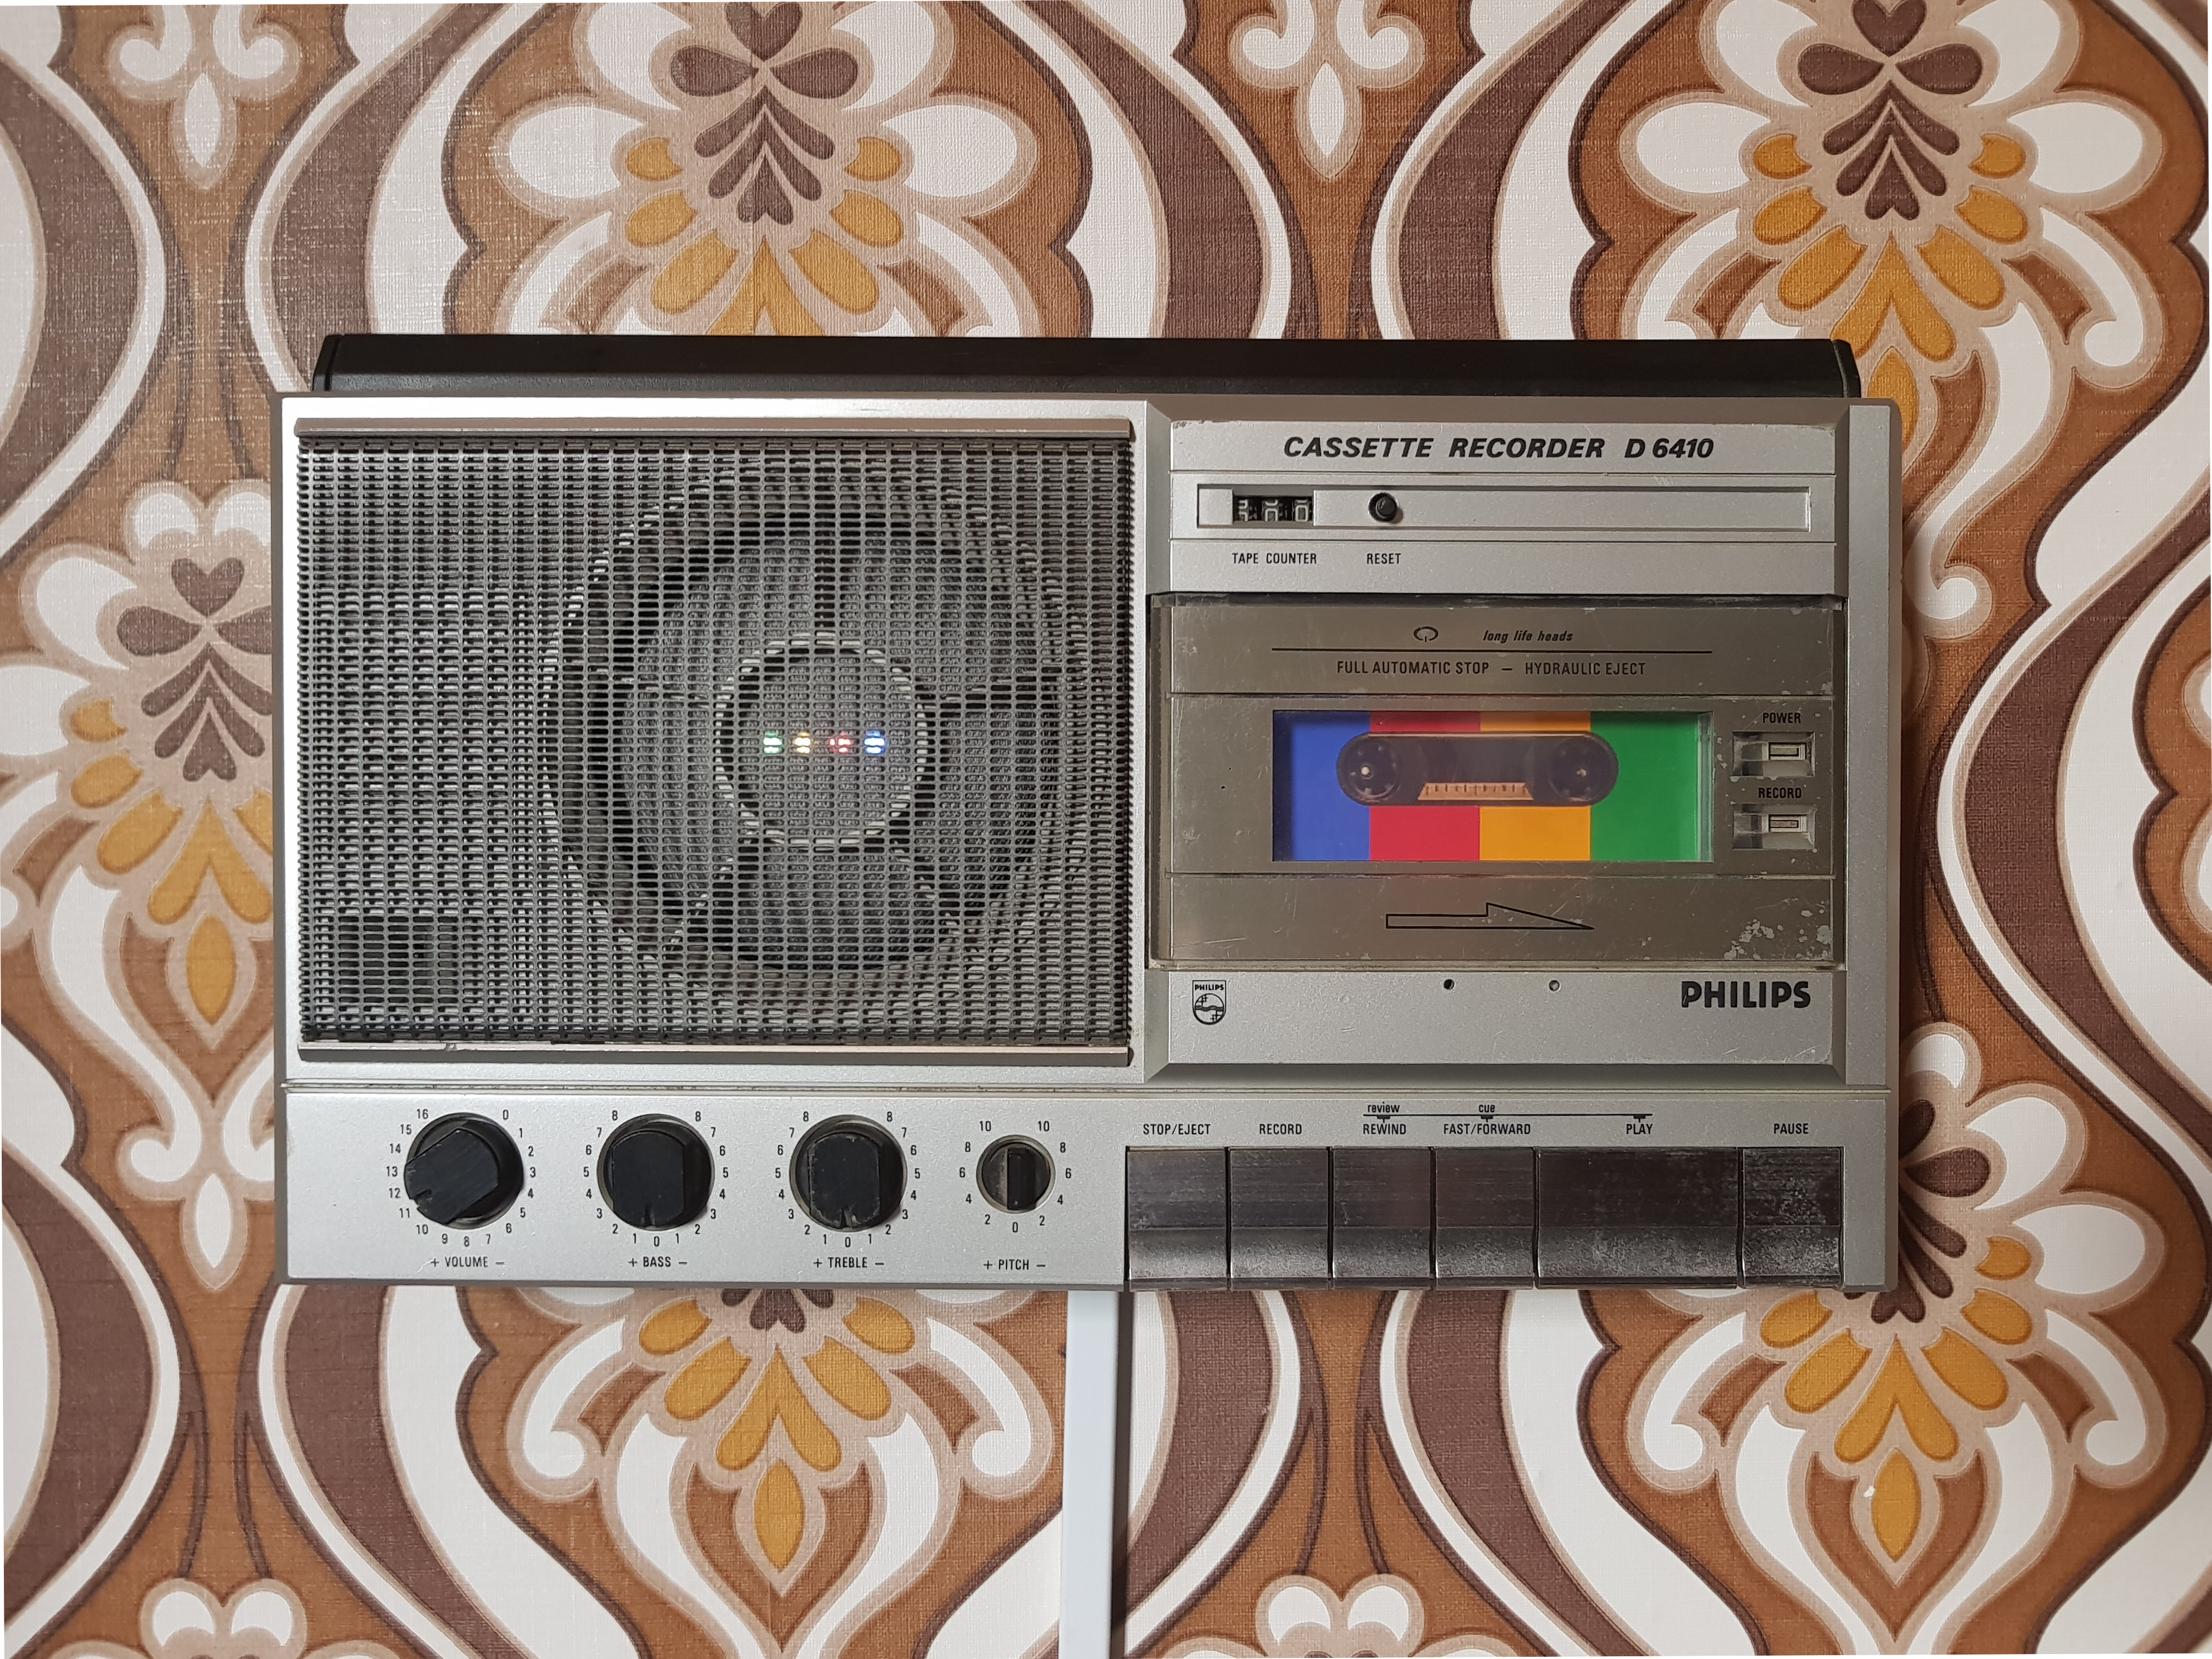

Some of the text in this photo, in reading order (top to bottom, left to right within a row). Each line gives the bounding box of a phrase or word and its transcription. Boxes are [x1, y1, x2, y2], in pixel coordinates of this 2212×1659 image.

[1284, 437, 1434, 458] CASSETTE
[1448, 437, 1605, 458] RECORDER
[1652, 438, 1714, 458] 6410
[1232, 552, 1317, 564] TAPE COUNTER
[1367, 553, 1401, 565] RESET
[1482, 630, 1573, 644] long life heads
[1338, 661, 1368, 674] FULL
[1372, 661, 1451, 675] AUTOMATIC
[1455, 661, 1489, 675] STOP
[1525, 662, 1600, 675] HYDRAULIC
[1606, 662, 1646, 675] EJECT
[1762, 712, 1801, 724] POWER
[1758, 787, 1802, 799] RECORD
[1681, 981, 1811, 1008] PHILIPS
[1368, 1101, 1400, 1113] review
[1479, 1104, 1496, 1113] cue
[416, 1108, 428, 1120] 16
[503, 1109, 509, 1120] 0
[612, 1110, 618, 1121] 8
[695, 1111, 701, 1122] 8
[803, 1111, 809, 1122] 8
[887, 1111, 893, 1122] 8
[400, 1124, 412, 1135] 15
[979, 1120, 991, 1132] 10
[1038, 1120, 1049, 1132] 10
[1143, 1124, 1211, 1135] STOP/EJECT
[1259, 1124, 1302, 1135] RECORD
[1363, 1123, 1407, 1135] REWIND
[1443, 1123, 1531, 1135] FAST/FORWARD
[1626, 1124, 1653, 1135] PLAY
[1774, 1123, 1809, 1135] PAUSE
[519, 1128, 523, 1138] 1
[597, 1127, 602, 1138] 7
[710, 1127, 716, 1138] 7
[789, 1127, 795, 1138] 7
[901, 1127, 907, 1138] 7
[390, 1143, 401, 1154] 14
[528, 1146, 534, 1157] 2
[585, 1144, 592, 1155] 6
[719, 1145, 726, 1156] 6
[777, 1144, 783, 1155] 6
[910, 1144, 917, 1155] 6
[964, 1142, 971, 1153] 8
[1060, 1142, 1066, 1153] 8
[386, 1166, 398, 1177] 13
[529, 1166, 536, 1178] 3
[583, 1166, 589, 1177] 5
[723, 1167, 729, 1178] 5
[775, 1167, 781, 1178] 5
[915, 1168, 921, 1179] 5
[959, 1167, 966, 1178] 6
[1065, 1167, 1071, 1179] 6
[388, 1187, 400, 1199] 12
[527, 1188, 534, 1198] 4
[586, 1188, 592, 1199] 4
[719, 1188, 726, 1199] 4
[778, 1189, 785, 1200] 4
[910, 1190, 917, 1200] 4
[965, 1193, 972, 1204] 4
[1057, 1194, 1064, 1205] 4
[399, 1207, 410, 1218] 11
[520, 1207, 526, 1218] 5
[596, 1208, 602, 1219] 3
[710, 1208, 716, 1219] 3
[788, 1209, 794, 1220] 3
[902, 1209, 909, 1220] 3
[984, 1214, 990, 1225] 2
[1039, 1215, 1045, 1226] 2
[416, 1224, 428, 1235] 10
[506, 1223, 512, 1233] 6
[612, 1223, 618, 1234] 2
[695, 1223, 701, 1234] 2
[804, 1224, 810, 1235] 2
[885, 1224, 891, 1235] 2
[1012, 1222, 1018, 1233] 0
[442, 1233, 448, 1244] 9
[464, 1235, 470, 1248] 8
[486, 1234, 491, 1244] 7
[633, 1233, 636, 1244] 1
[653, 1235, 660, 1247] 0
[675, 1233, 679, 1244] 1
[823, 1234, 827, 1245] 1
[845, 1237, 851, 1248] 0
[868, 1233, 872, 1244] 1
[444, 1256, 488, 1268] VOLUME
[643, 1256, 671, 1267] BASS
[827, 1257, 867, 1268] TREBLE
[998, 1259, 1029, 1270] PITCH
